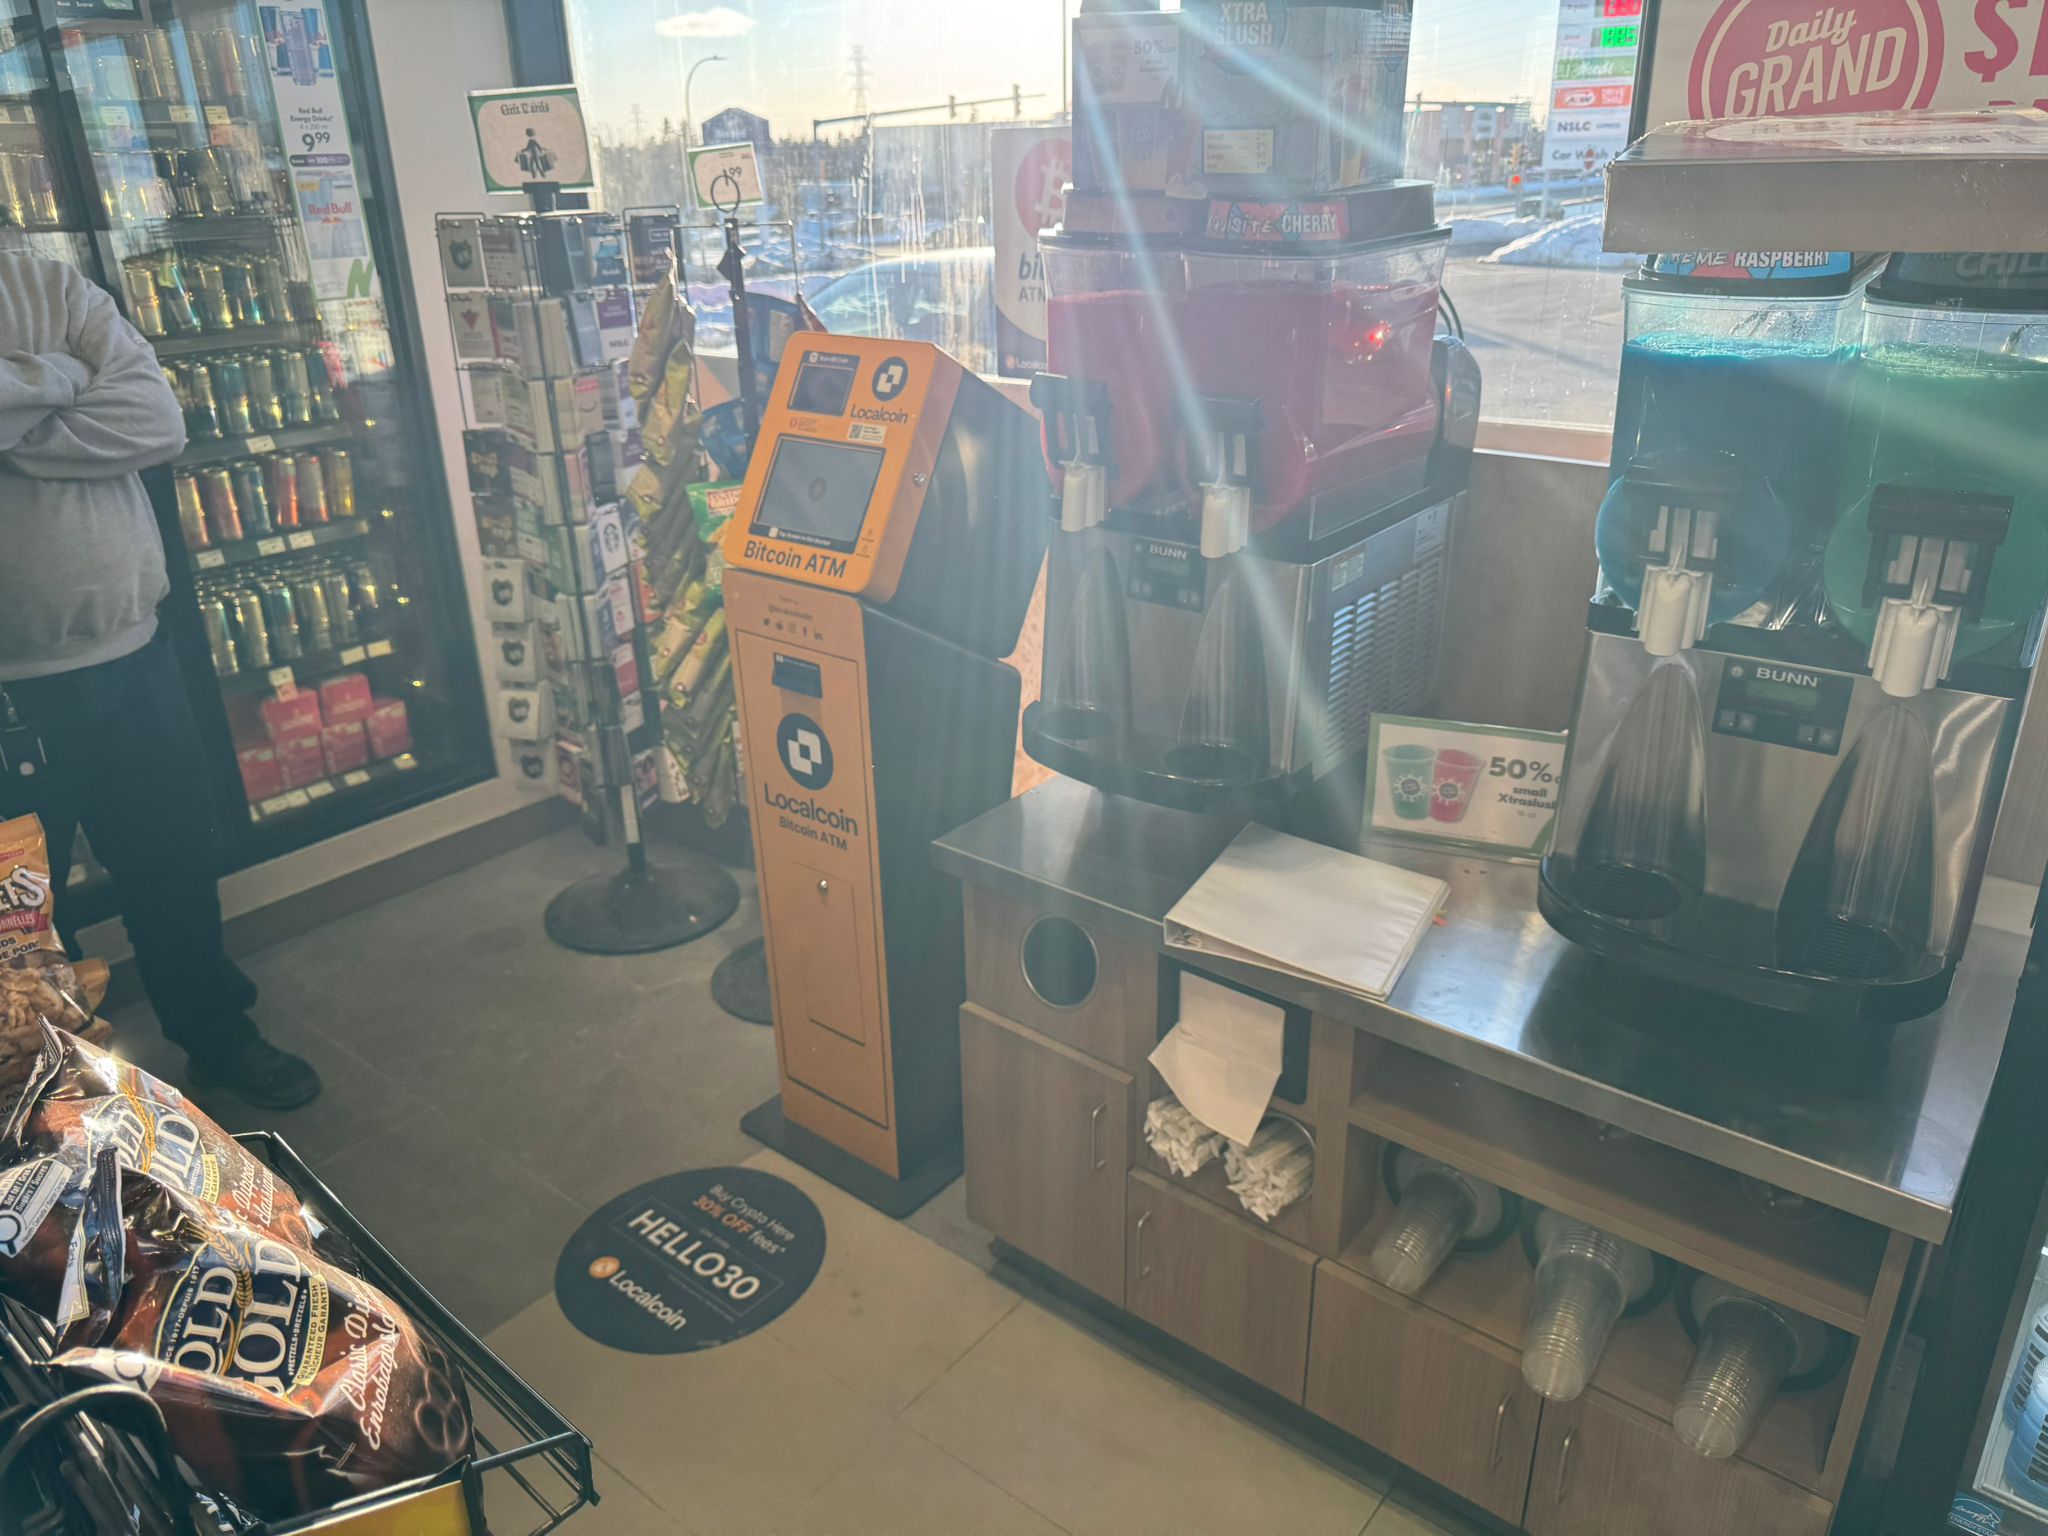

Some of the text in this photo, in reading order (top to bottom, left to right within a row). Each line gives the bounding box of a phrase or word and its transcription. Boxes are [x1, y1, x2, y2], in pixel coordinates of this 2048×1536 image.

[1219, 2, 1269, 24] XTRA
[1765, 6, 1857, 53] Daily
[1213, 23, 1273, 45] SLUSH
[1723, 27, 1908, 119] GRAND
[1557, 121, 1591, 133] NSLC
[1552, 150, 1572, 161] Car
[1281, 213, 1338, 234] CHERRY
[1733, 250, 1829, 268] RASPBERRY
[1954, 251, 2048, 278] CHIL
[850, 404, 909, 424] Localcoin
[743, 539, 848, 579] Bitcoin ATM
[1149, 544, 1188, 560] BUNN
[1756, 667, 1819, 688] BUNN
[1488, 756, 1553, 784] 50%
[1512, 785, 1548, 798] small
[763, 782, 859, 836] Localcoin
[779, 815, 848, 851] Bitcoin ATM
[149, 1113, 200, 1191] LD
[2, 1191, 16, 1207] Sat
[9, 1182, 21, 1195] fat
[13, 1163, 49, 1212] Sugars Sucres
[232, 1152, 255, 1209] Dipped
[710, 1184, 796, 1242] Buy Crypto Here
[722, 1212, 754, 1235] OFF
[627, 1208, 761, 1300] HELLO30
[178, 1289, 195, 1320] DEPUIS
[318, 1281, 328, 1333] GARANTIE
[608, 1269, 688, 1332] Localcoin
[287, 1294, 307, 1375] PRETZELS BRETZELS
[297, 1283, 320, 1382] GUARANTEED FRESH
[340, 1343, 368, 1412] Classic
